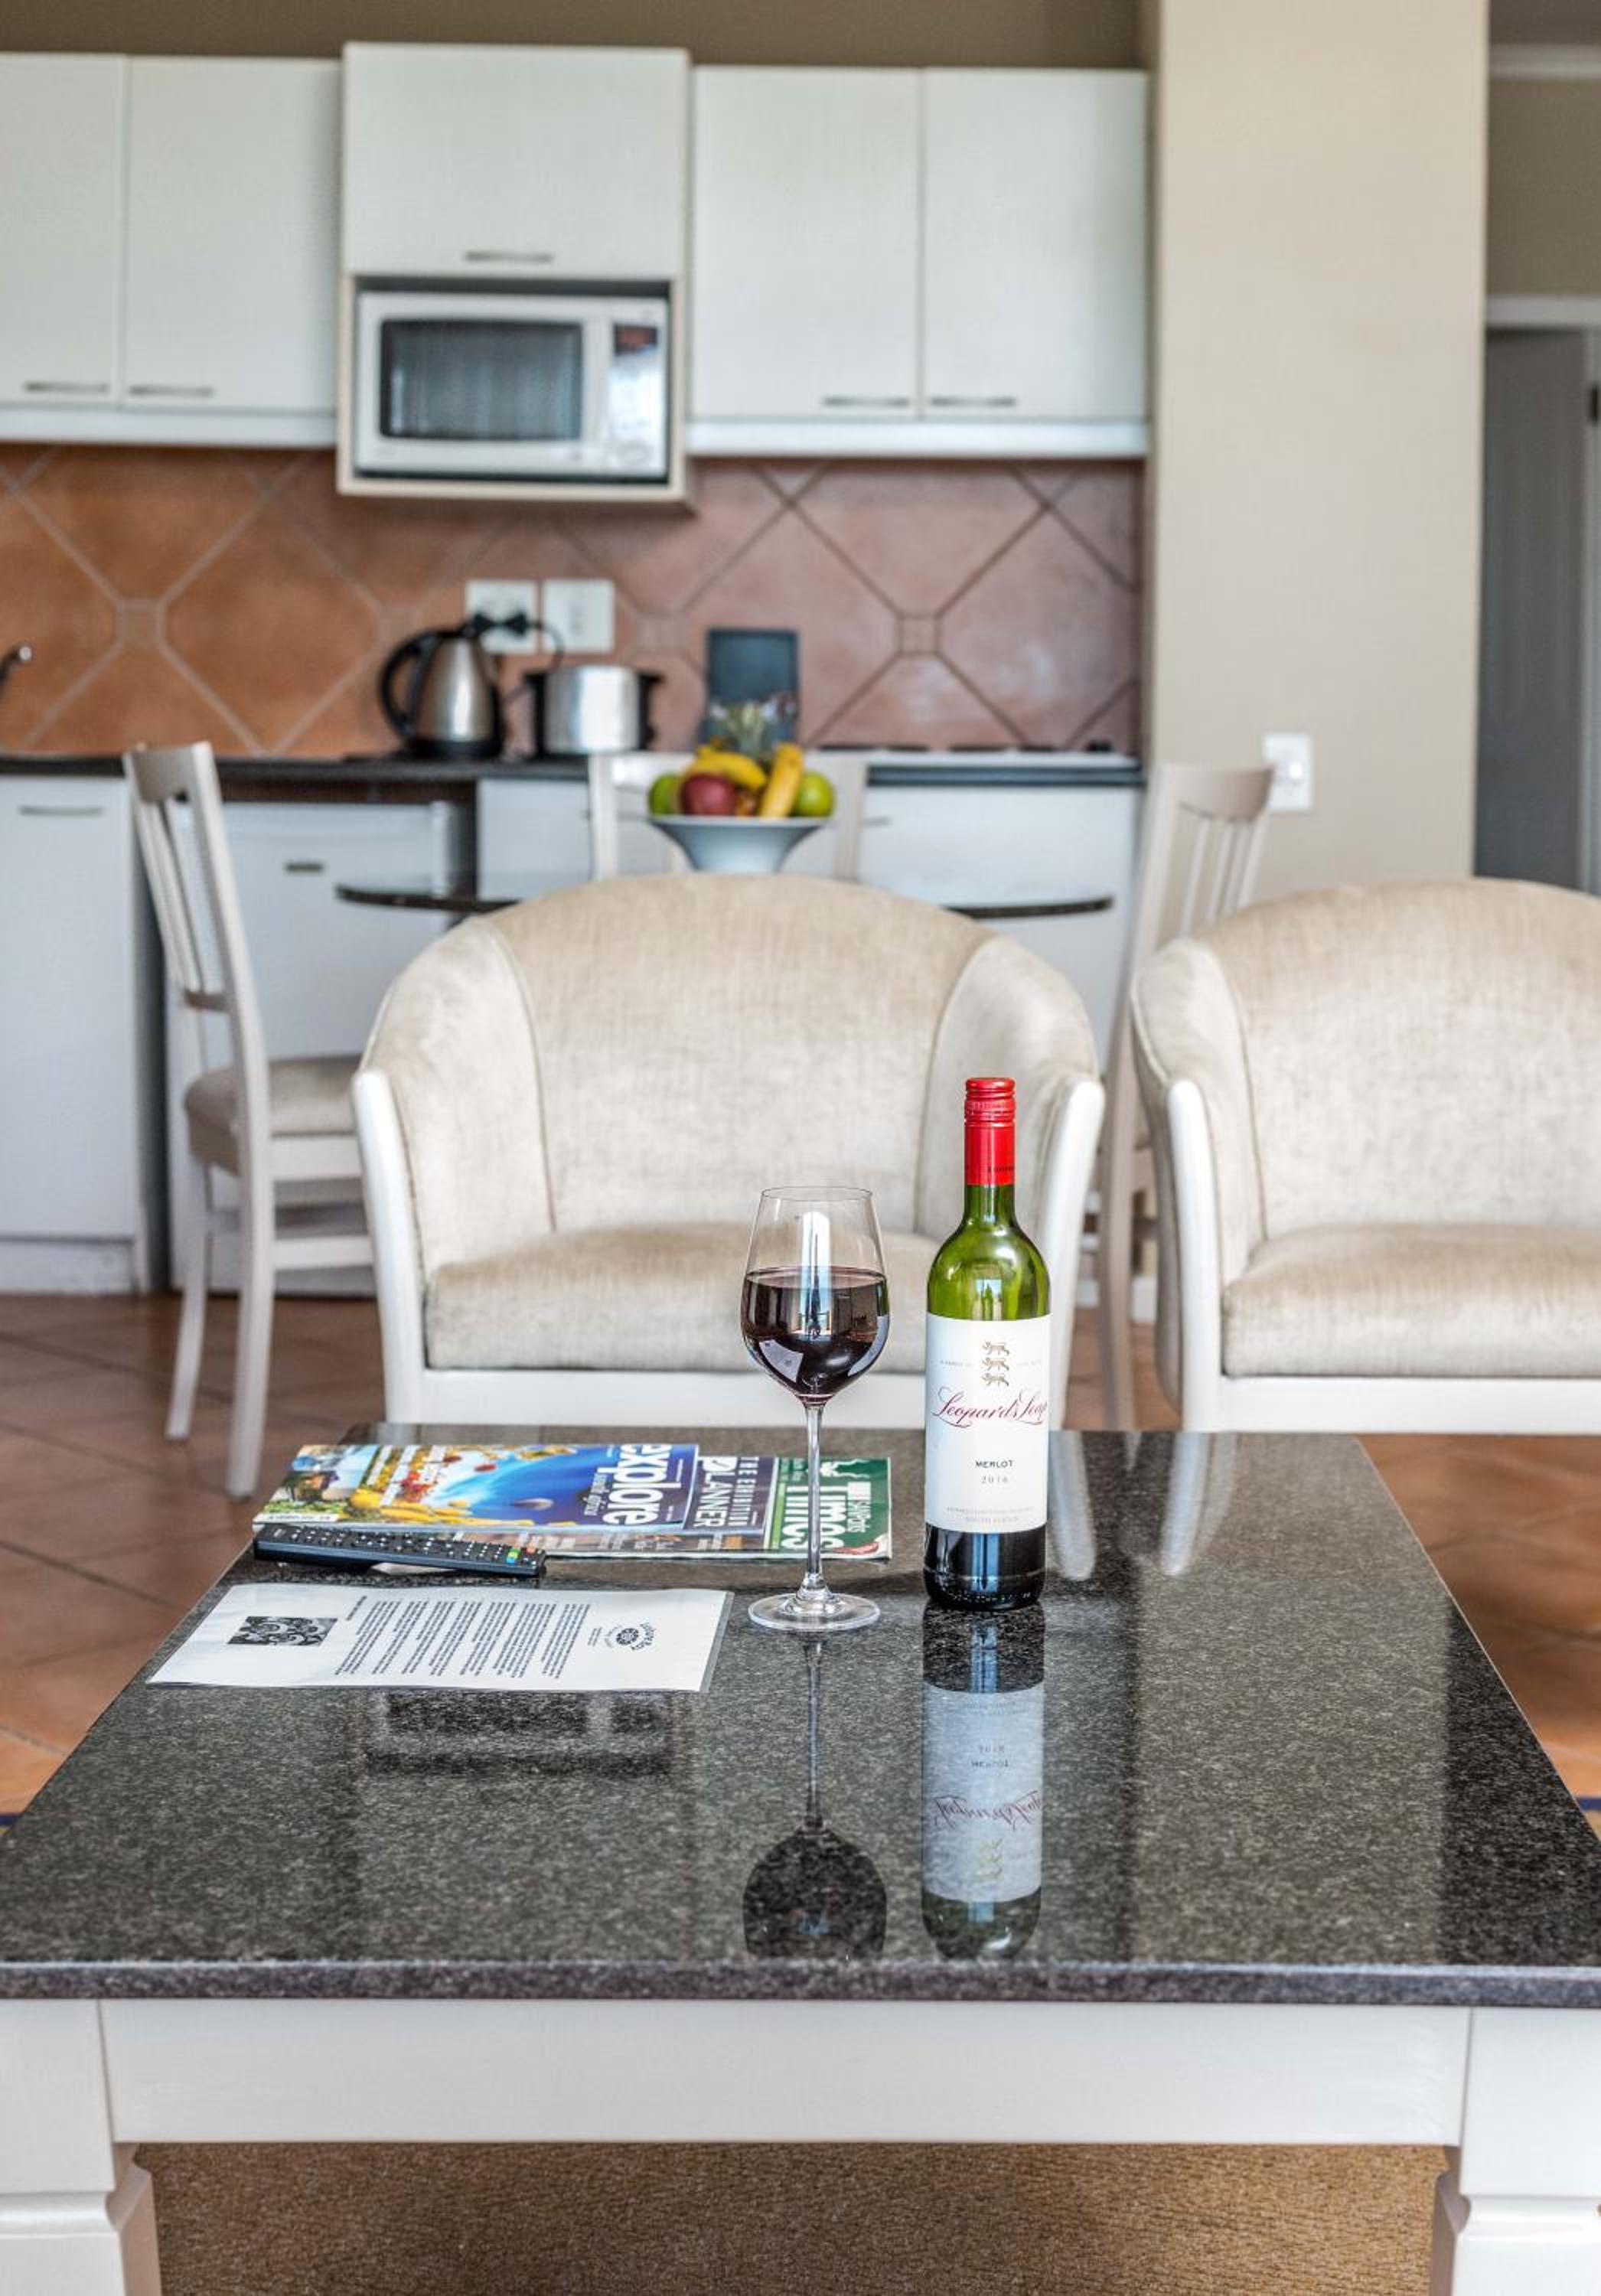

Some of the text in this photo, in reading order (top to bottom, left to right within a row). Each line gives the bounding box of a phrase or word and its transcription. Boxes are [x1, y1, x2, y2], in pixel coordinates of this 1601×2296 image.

[597, 1443, 682, 1526] explore
[693, 1456, 738, 1528] PLANNER
[975, 1459, 1013, 1469] MERLOT
[781, 1486, 848, 1549] Times
